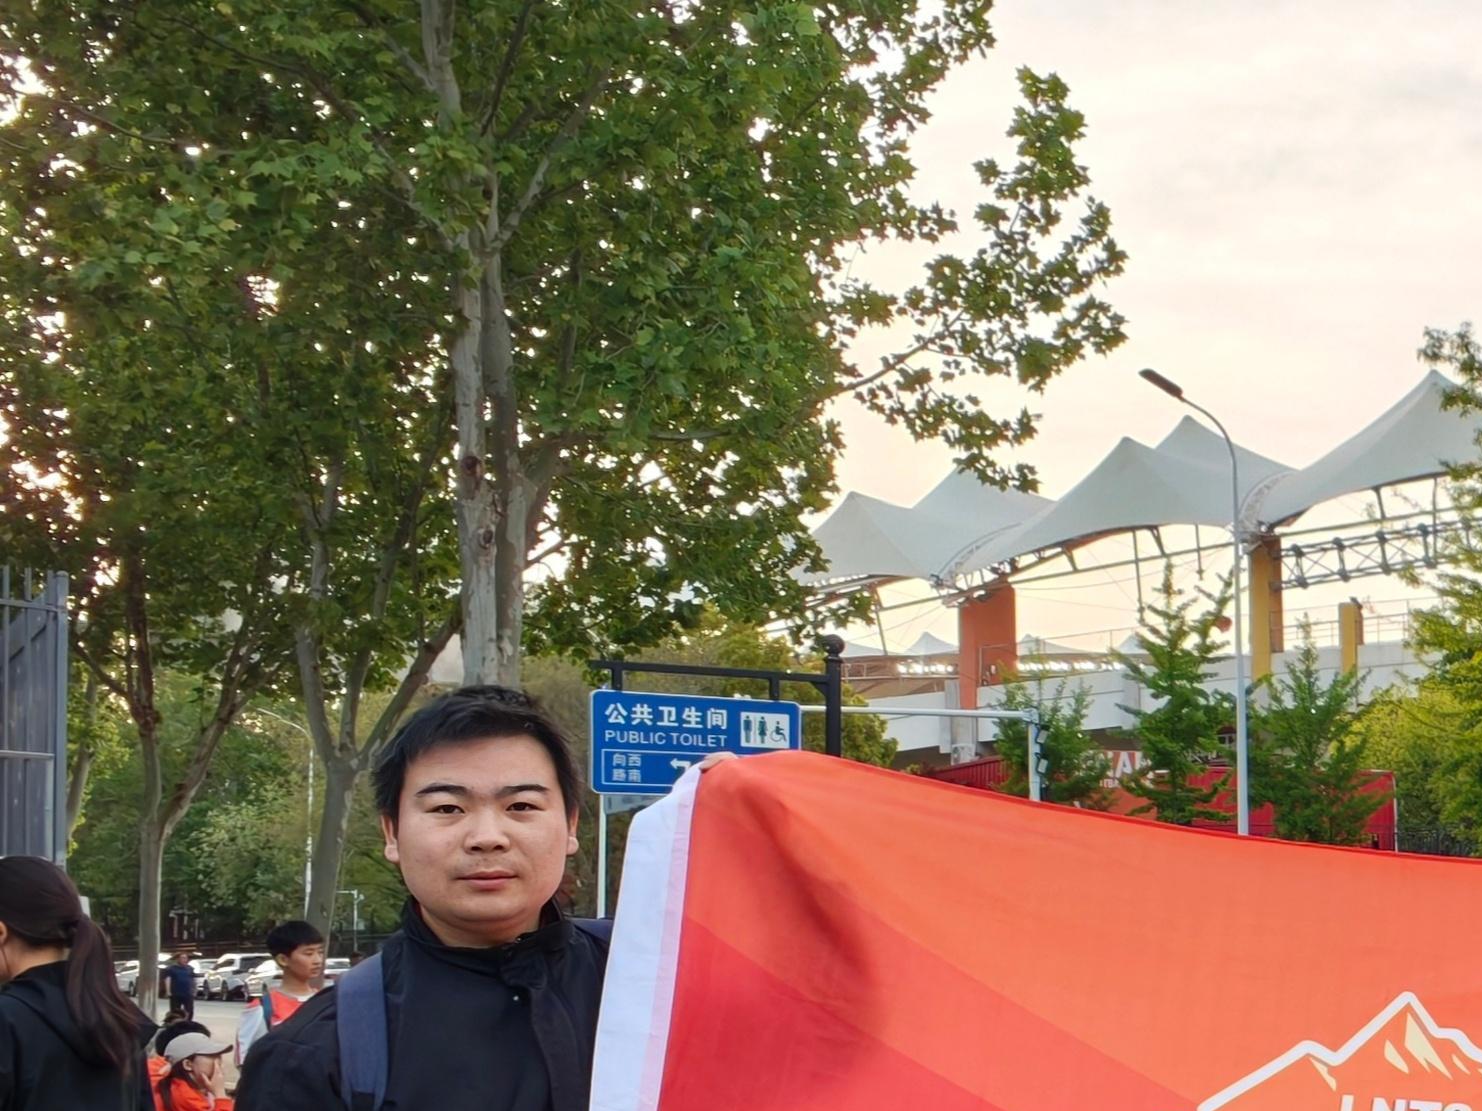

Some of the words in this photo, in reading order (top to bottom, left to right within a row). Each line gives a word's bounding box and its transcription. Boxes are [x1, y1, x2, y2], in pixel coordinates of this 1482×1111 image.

[604, 702, 728, 729] 公共卫生间
[604, 730, 666, 745] PUBLIC
[669, 732, 728, 747] TOILET
